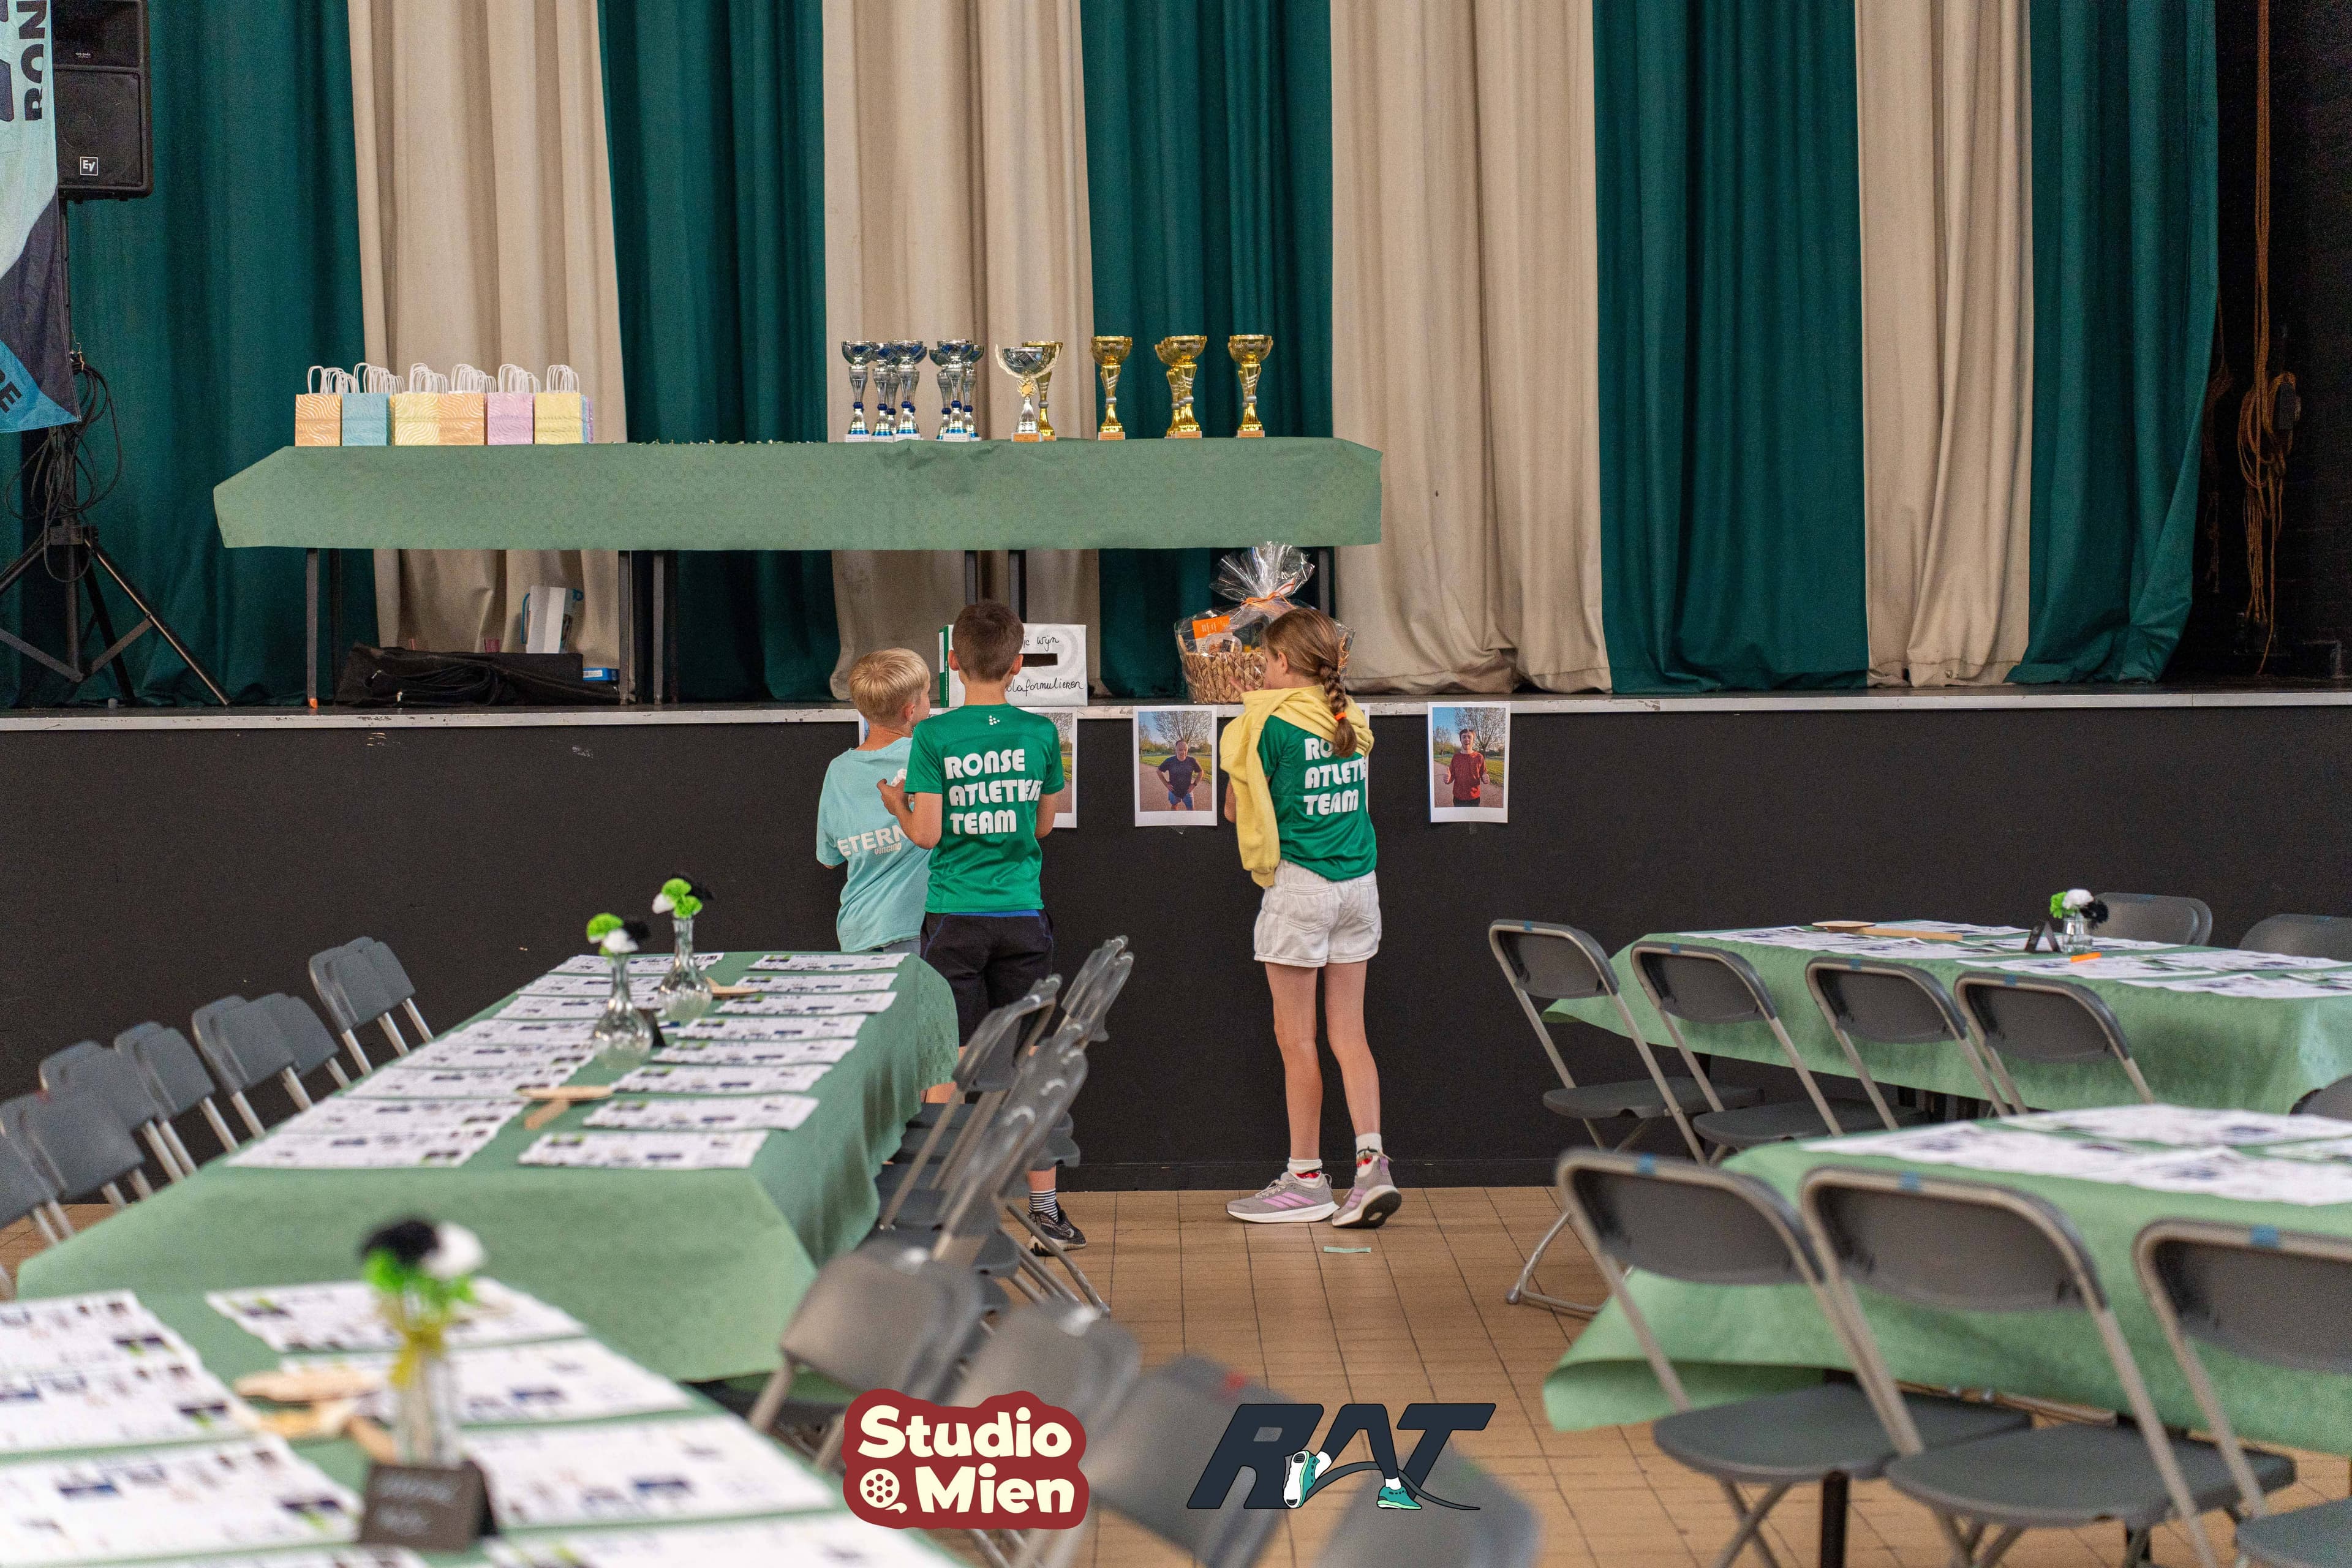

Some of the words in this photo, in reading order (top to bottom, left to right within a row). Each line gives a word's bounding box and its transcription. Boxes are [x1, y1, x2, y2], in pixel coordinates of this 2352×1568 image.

[944, 748, 1025, 779] RONSE
[1303, 789, 1359, 815] TEAM
[950, 809, 1017, 835] TEAM
